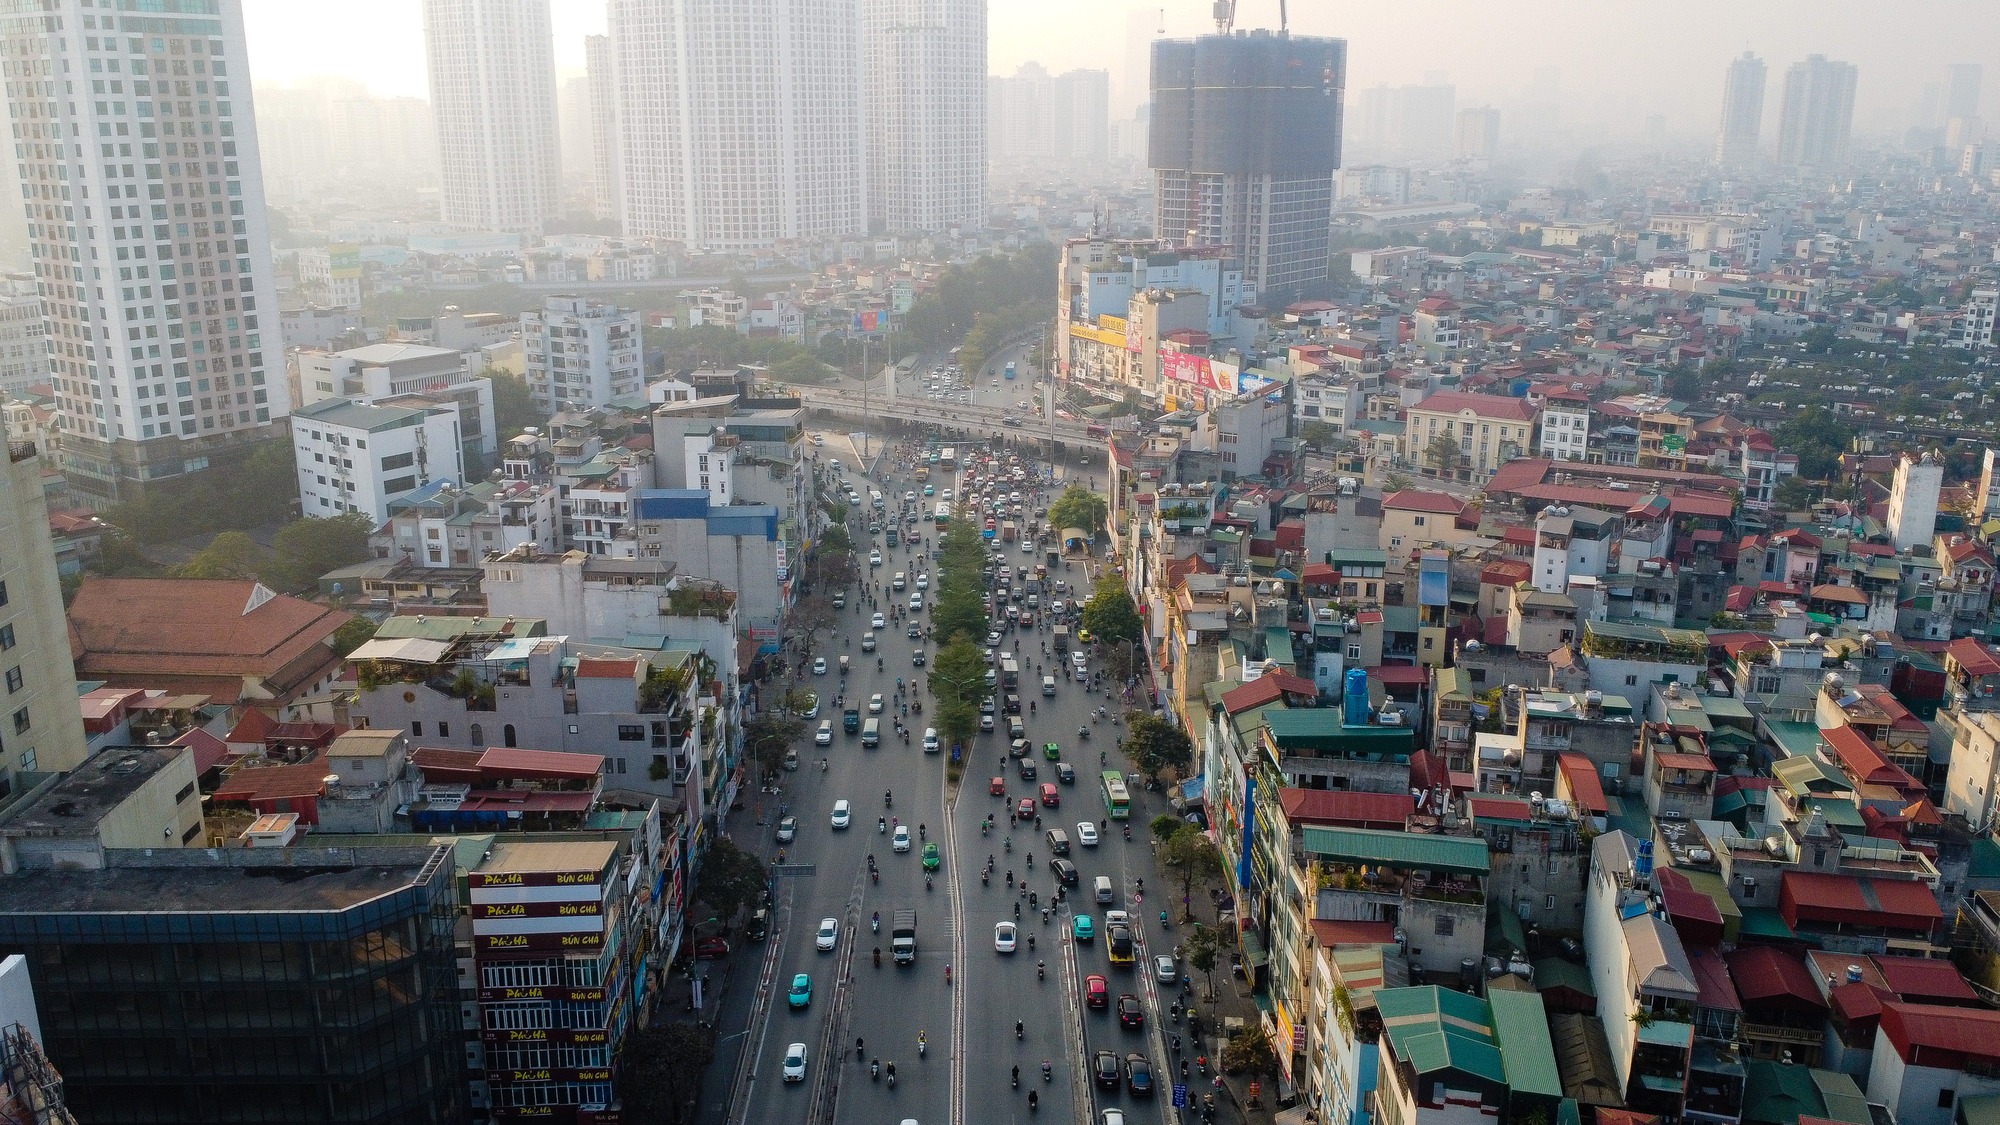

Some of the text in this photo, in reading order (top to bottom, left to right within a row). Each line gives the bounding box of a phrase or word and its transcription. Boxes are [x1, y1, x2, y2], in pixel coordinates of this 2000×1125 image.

[557, 872, 595, 883] BÚN CHẢ
[560, 902, 597, 914] BÚN CHẢ
[562, 933, 599, 945] BÚN CHẢ
[571, 990, 601, 1000] BÚN CHẢ
[575, 1032, 604, 1042] BÚN CHẢ
[579, 1069, 608, 1079] BÚN CHẢ
